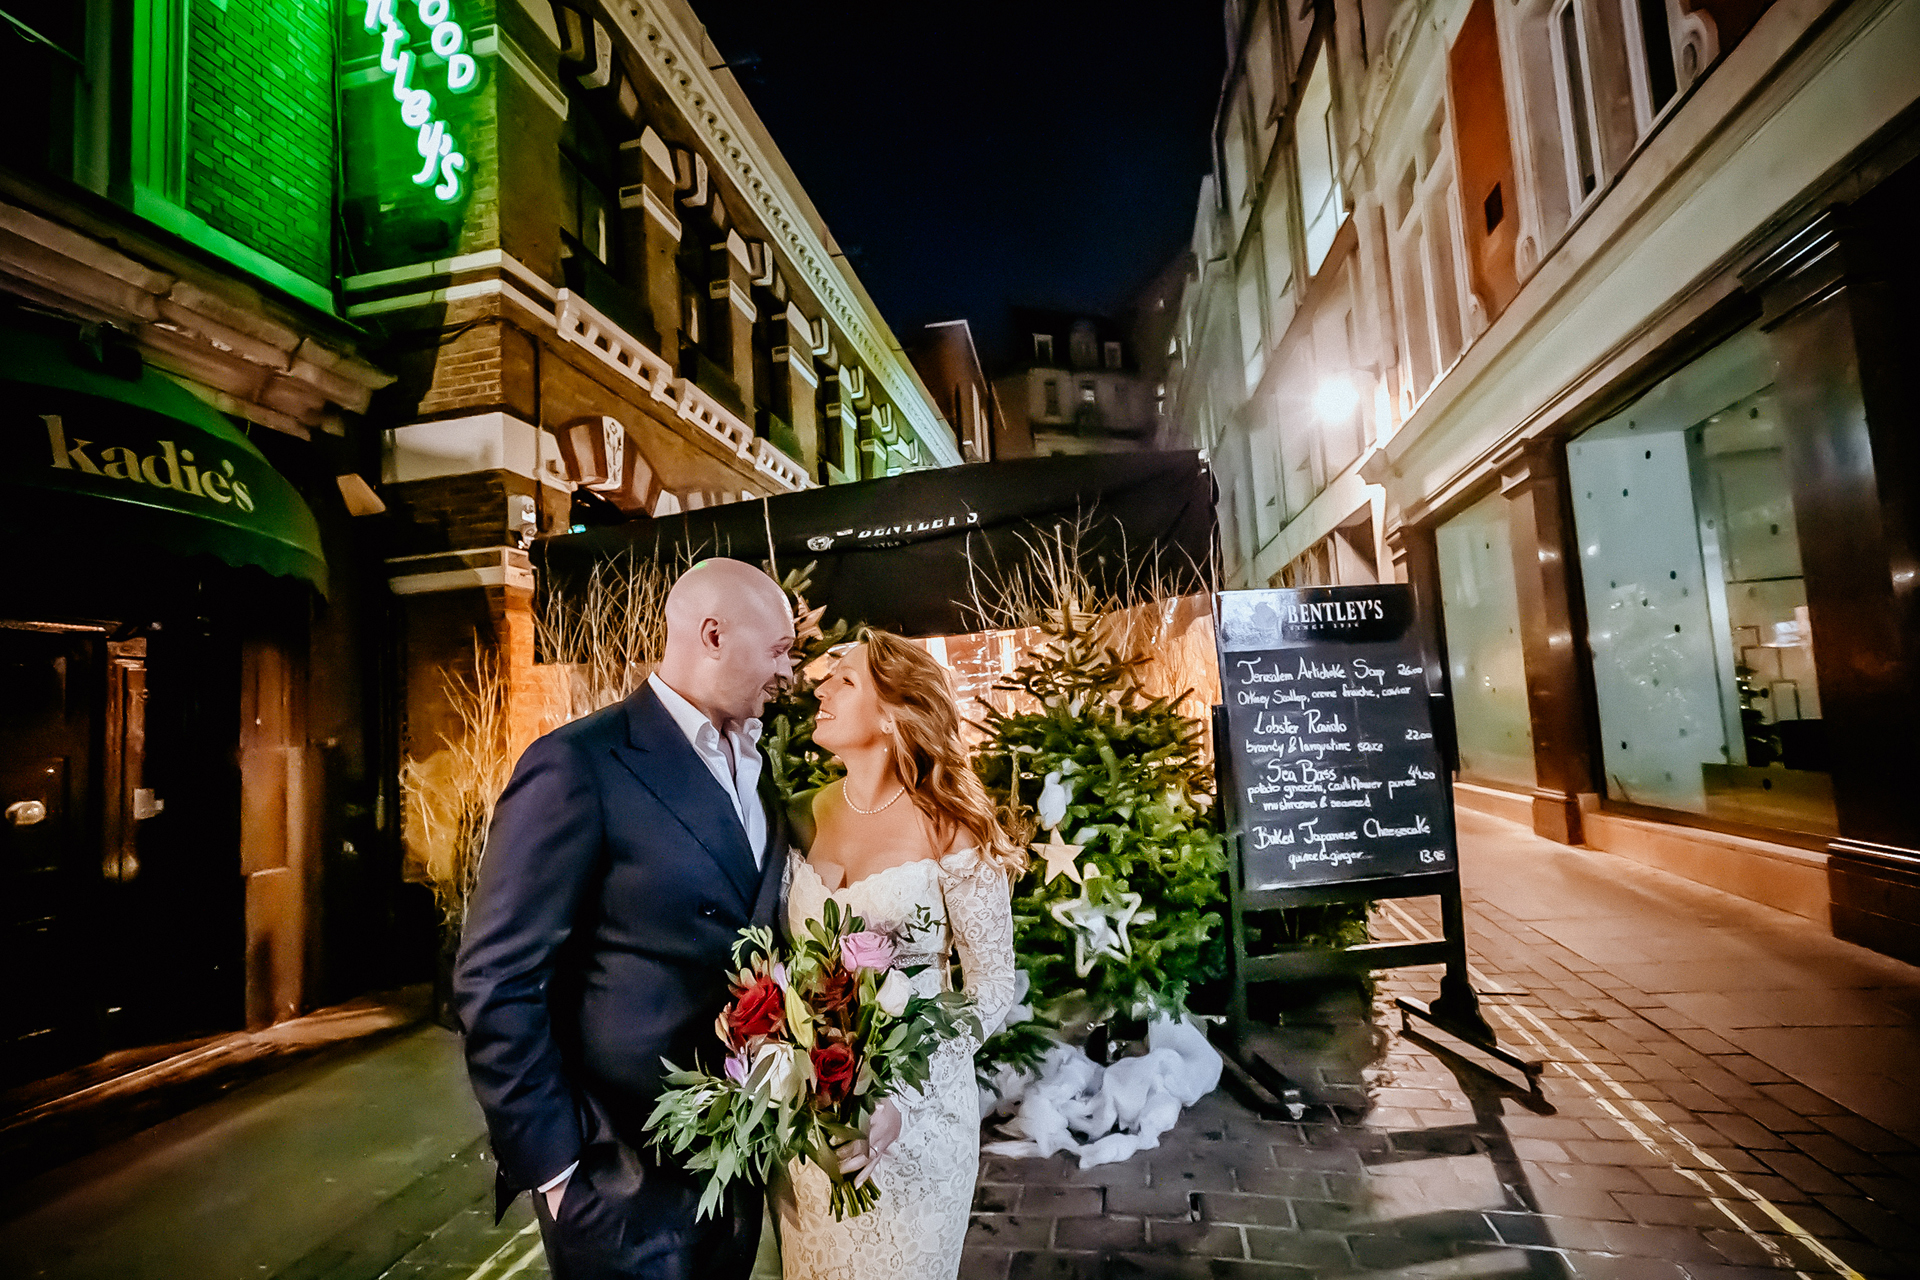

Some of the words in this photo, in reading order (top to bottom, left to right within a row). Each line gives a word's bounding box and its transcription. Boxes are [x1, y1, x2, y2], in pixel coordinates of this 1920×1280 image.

[38, 414, 255, 513] kadie's
[1287, 599, 1384, 624] BENTLEY'S
[1236, 657, 1294, 685] Jerusalem
[1353, 658, 1386, 685] Soup
[1253, 711, 1300, 735] Lobster
[1245, 738, 1285, 758] brandy
[1287, 736, 1297, 754] &
[1266, 758, 1298, 783] Sea
[1295, 759, 1337, 784] Bass
[1247, 781, 1281, 803] potato
[1298, 817, 1359, 853] Japanese
